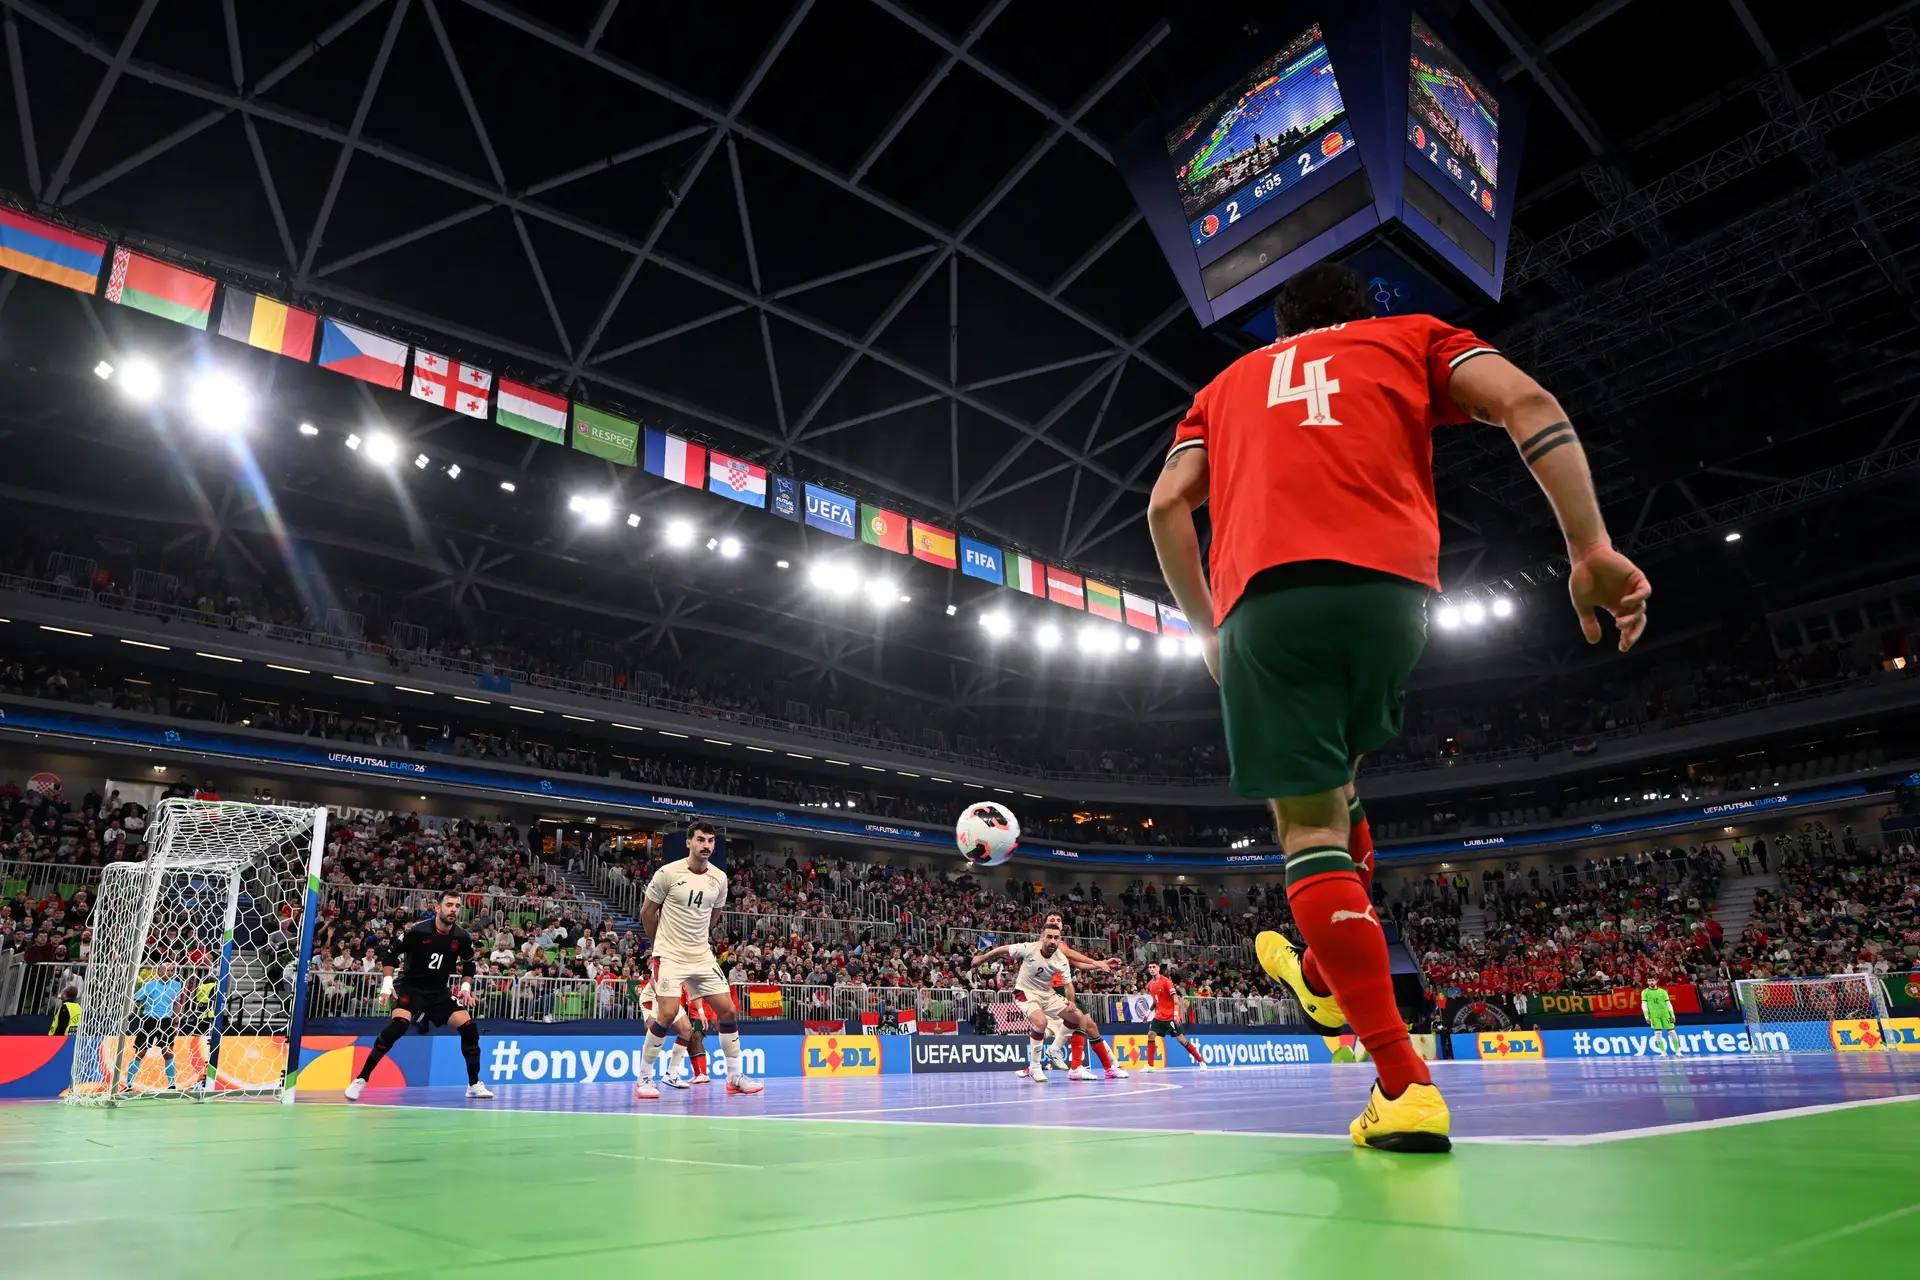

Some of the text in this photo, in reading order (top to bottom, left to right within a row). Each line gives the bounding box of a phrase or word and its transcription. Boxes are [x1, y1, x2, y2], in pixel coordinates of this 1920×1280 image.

[1226, 201, 1242, 224] 2
[1254, 173, 1283, 198] 6:05
[1297, 152, 1315, 176] 2
[1266, 344, 1344, 426] 4
[591, 427, 635, 449] RESPECT
[806, 496, 852, 526] UEFA
[966, 549, 997, 571] FIFA
[652, 795, 694, 808] LJUBLJANA
[1463, 837, 1505, 847] LJUBLJANA
[1052, 849, 1079, 858] LJUBLJANA
[687, 889, 704, 908] 14
[428, 952, 444, 970] 21
[1035, 967, 1044, 977] 2
[1541, 992, 1641, 1013] PORTUGA
[916, 1044, 961, 1064] UEFA
[962, 1044, 1025, 1063] FUTSAL
[1188, 1038, 1309, 1067] #onyourteam
